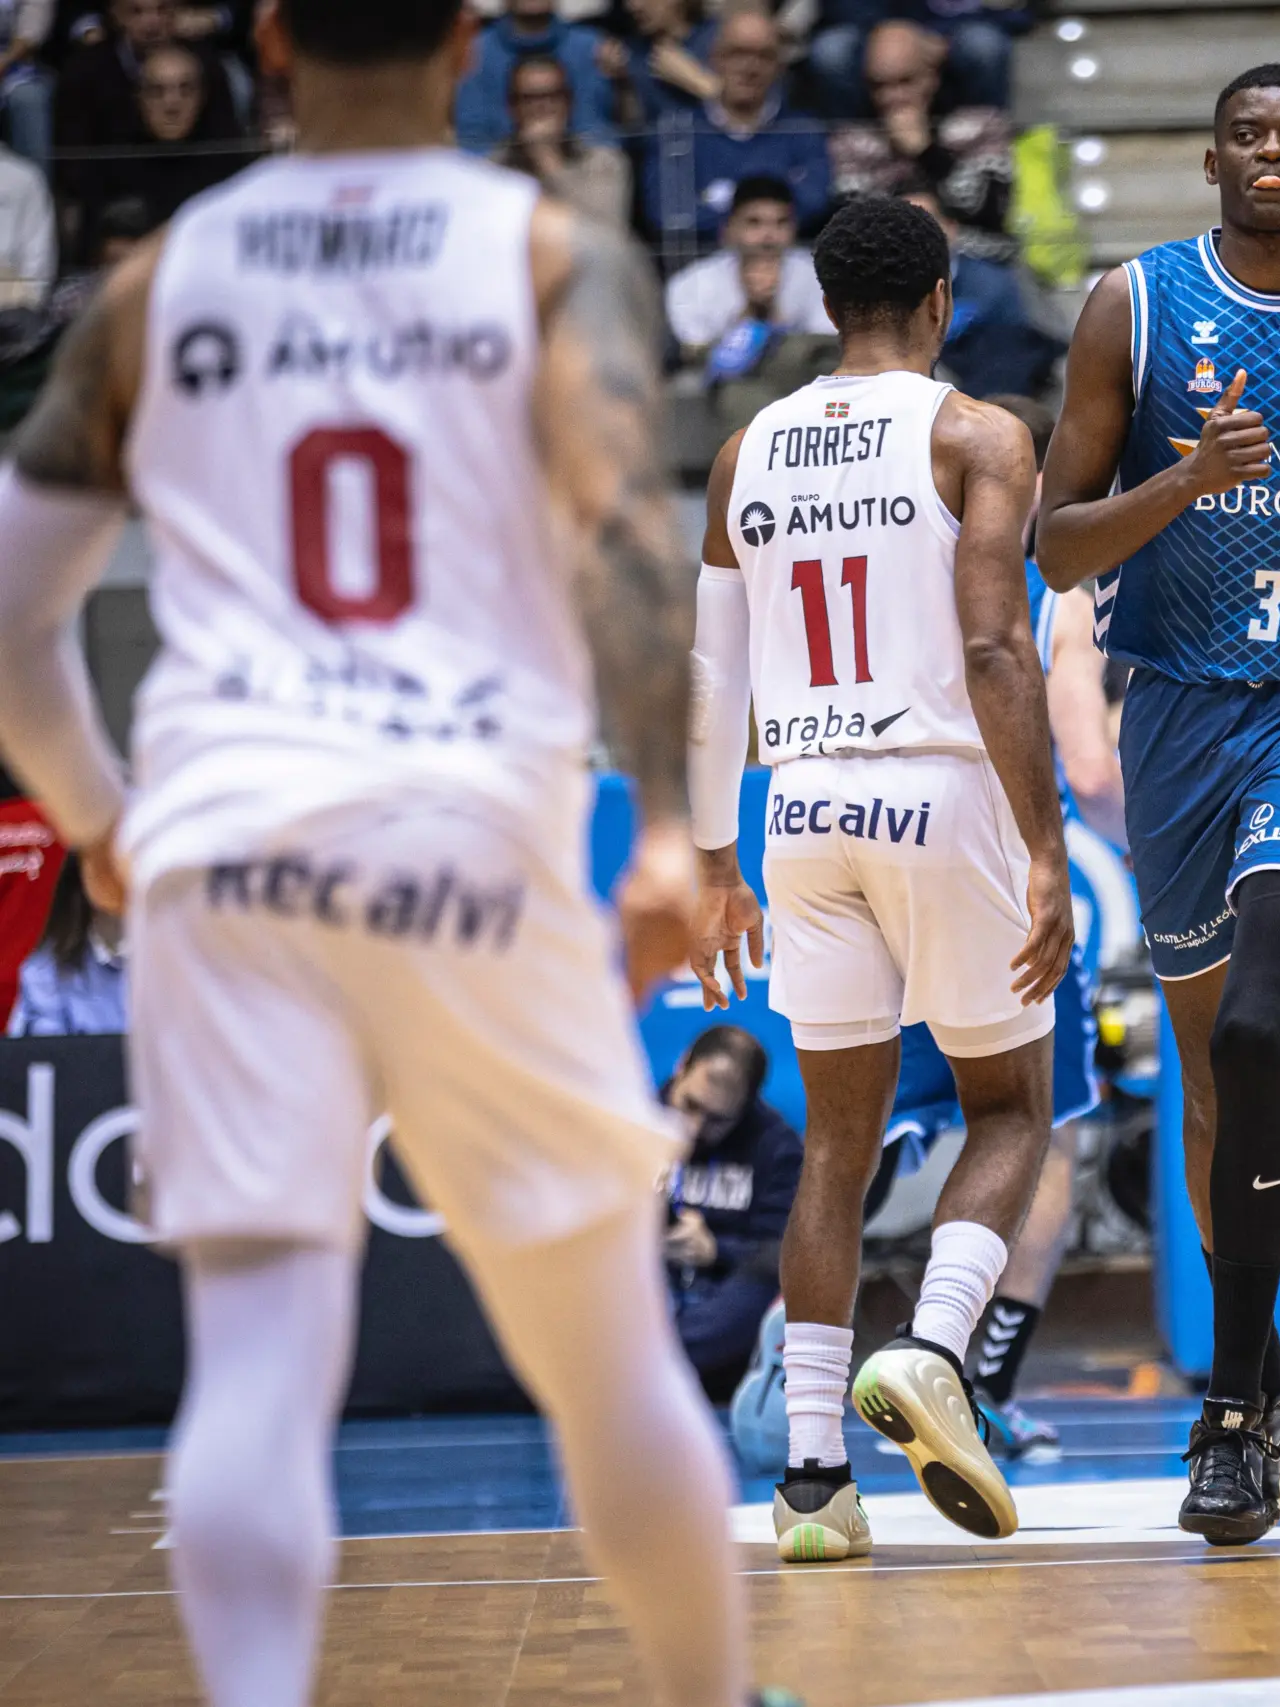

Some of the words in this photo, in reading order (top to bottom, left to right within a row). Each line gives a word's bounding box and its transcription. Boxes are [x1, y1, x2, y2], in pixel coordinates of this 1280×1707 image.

[1190, 379, 1220, 390] BURGOS
[767, 418, 892, 471] FORREST
[787, 496, 915, 536] AMUTIO
[791, 493, 820, 503] GRUPO
[287, 424, 416, 630] 0
[790, 555, 874, 688] 11
[765, 705, 865, 747] araba
[768, 793, 931, 846] Recalvi
[1153, 929, 1197, 944] CASTILLA
[1199, 923, 1207, 935] Y
